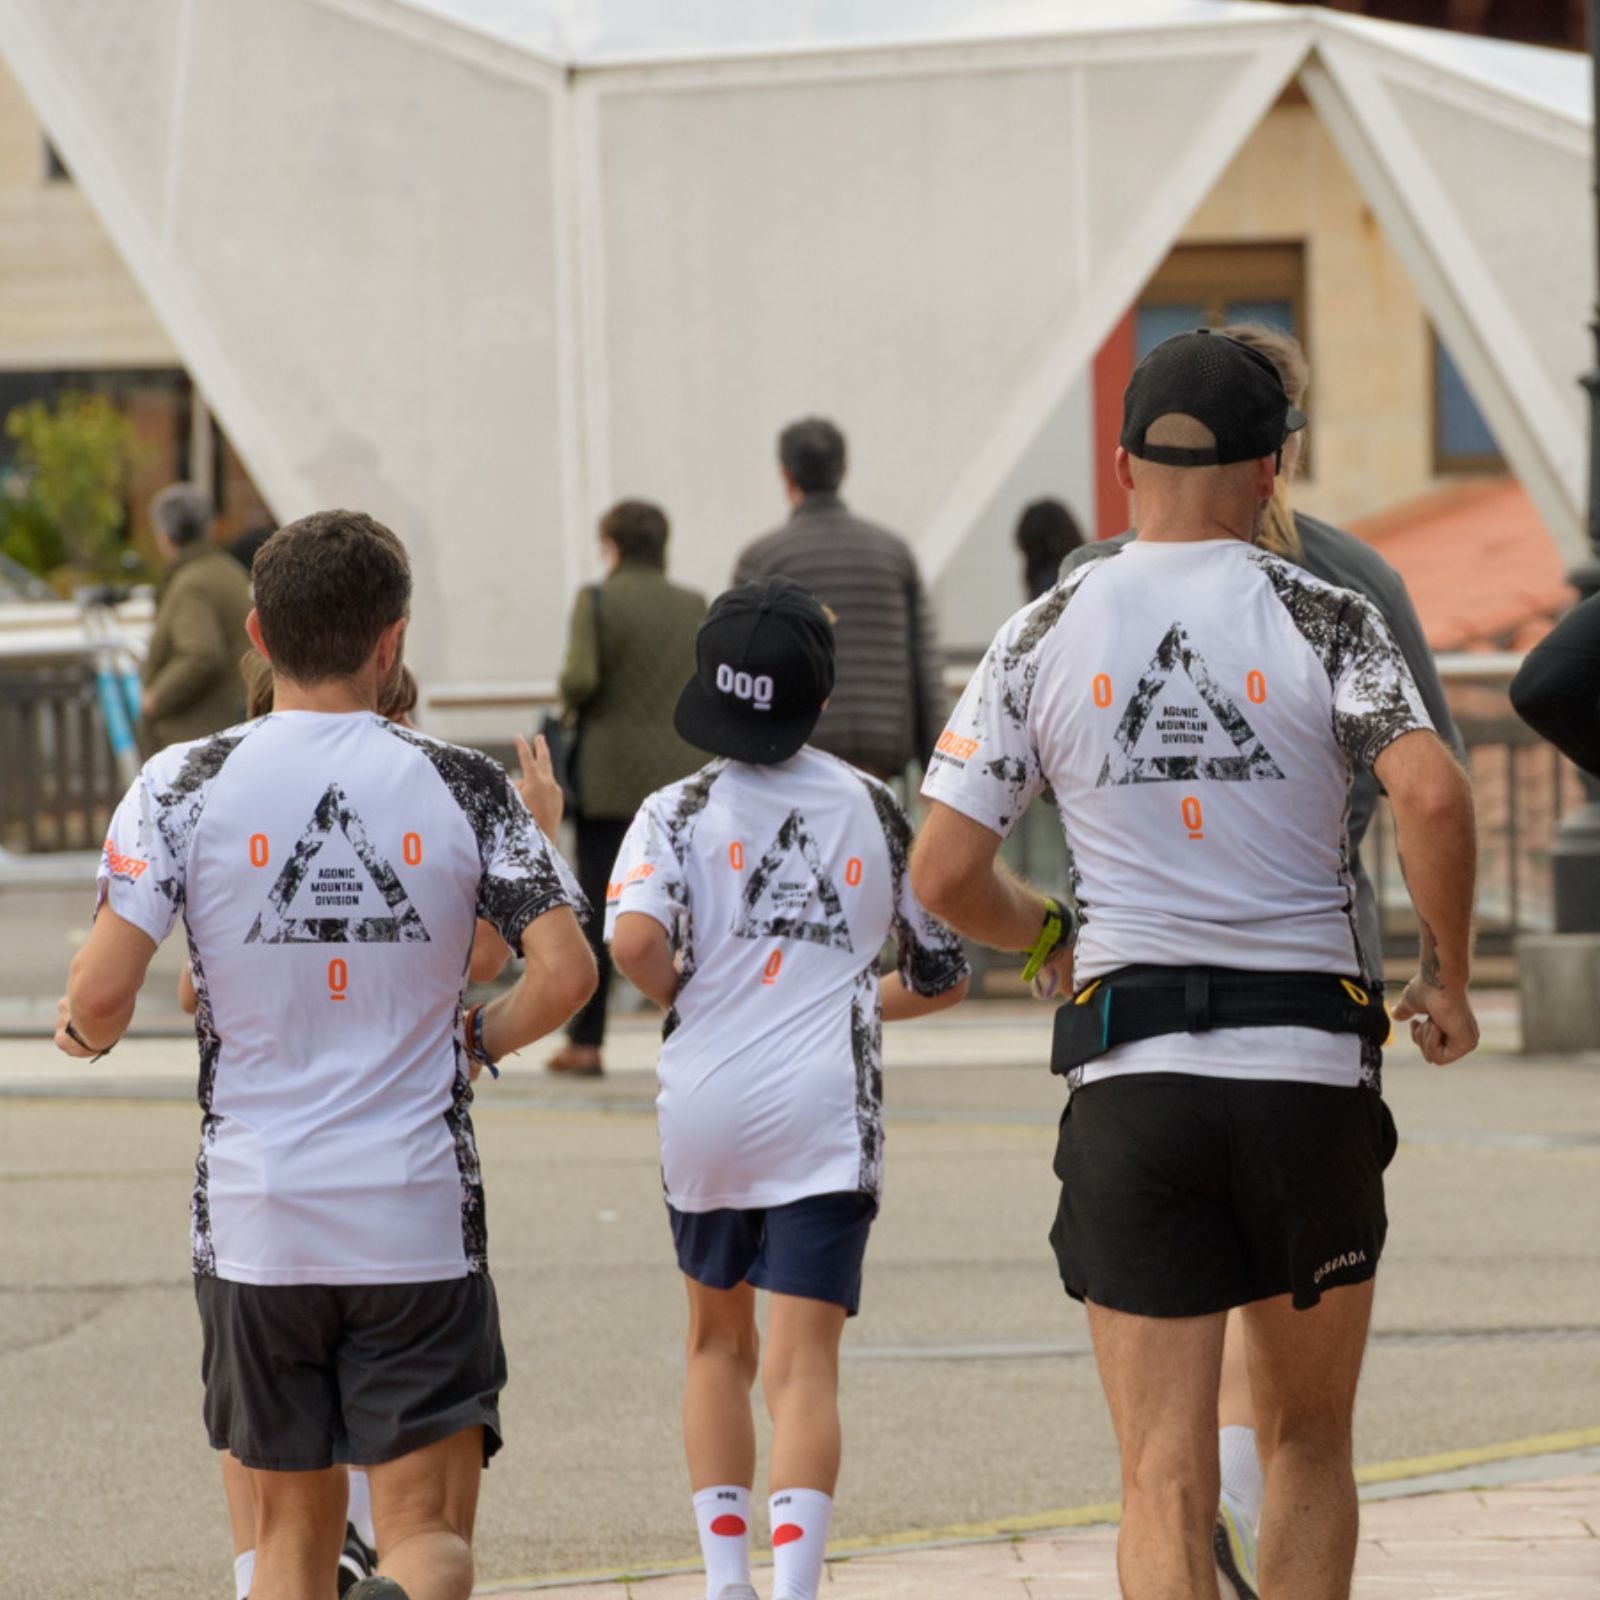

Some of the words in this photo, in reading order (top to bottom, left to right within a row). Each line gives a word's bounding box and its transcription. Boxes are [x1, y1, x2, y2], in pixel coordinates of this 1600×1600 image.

[1163, 705, 1199, 718] AGONIC
[1156, 720, 1208, 732] MOUNTAIN
[1161, 733, 1204, 744] DIVISION
[318, 868, 356, 879] AGONIC
[311, 882, 364, 892] MOUNTAIN
[315, 895, 360, 906] DIVISION
